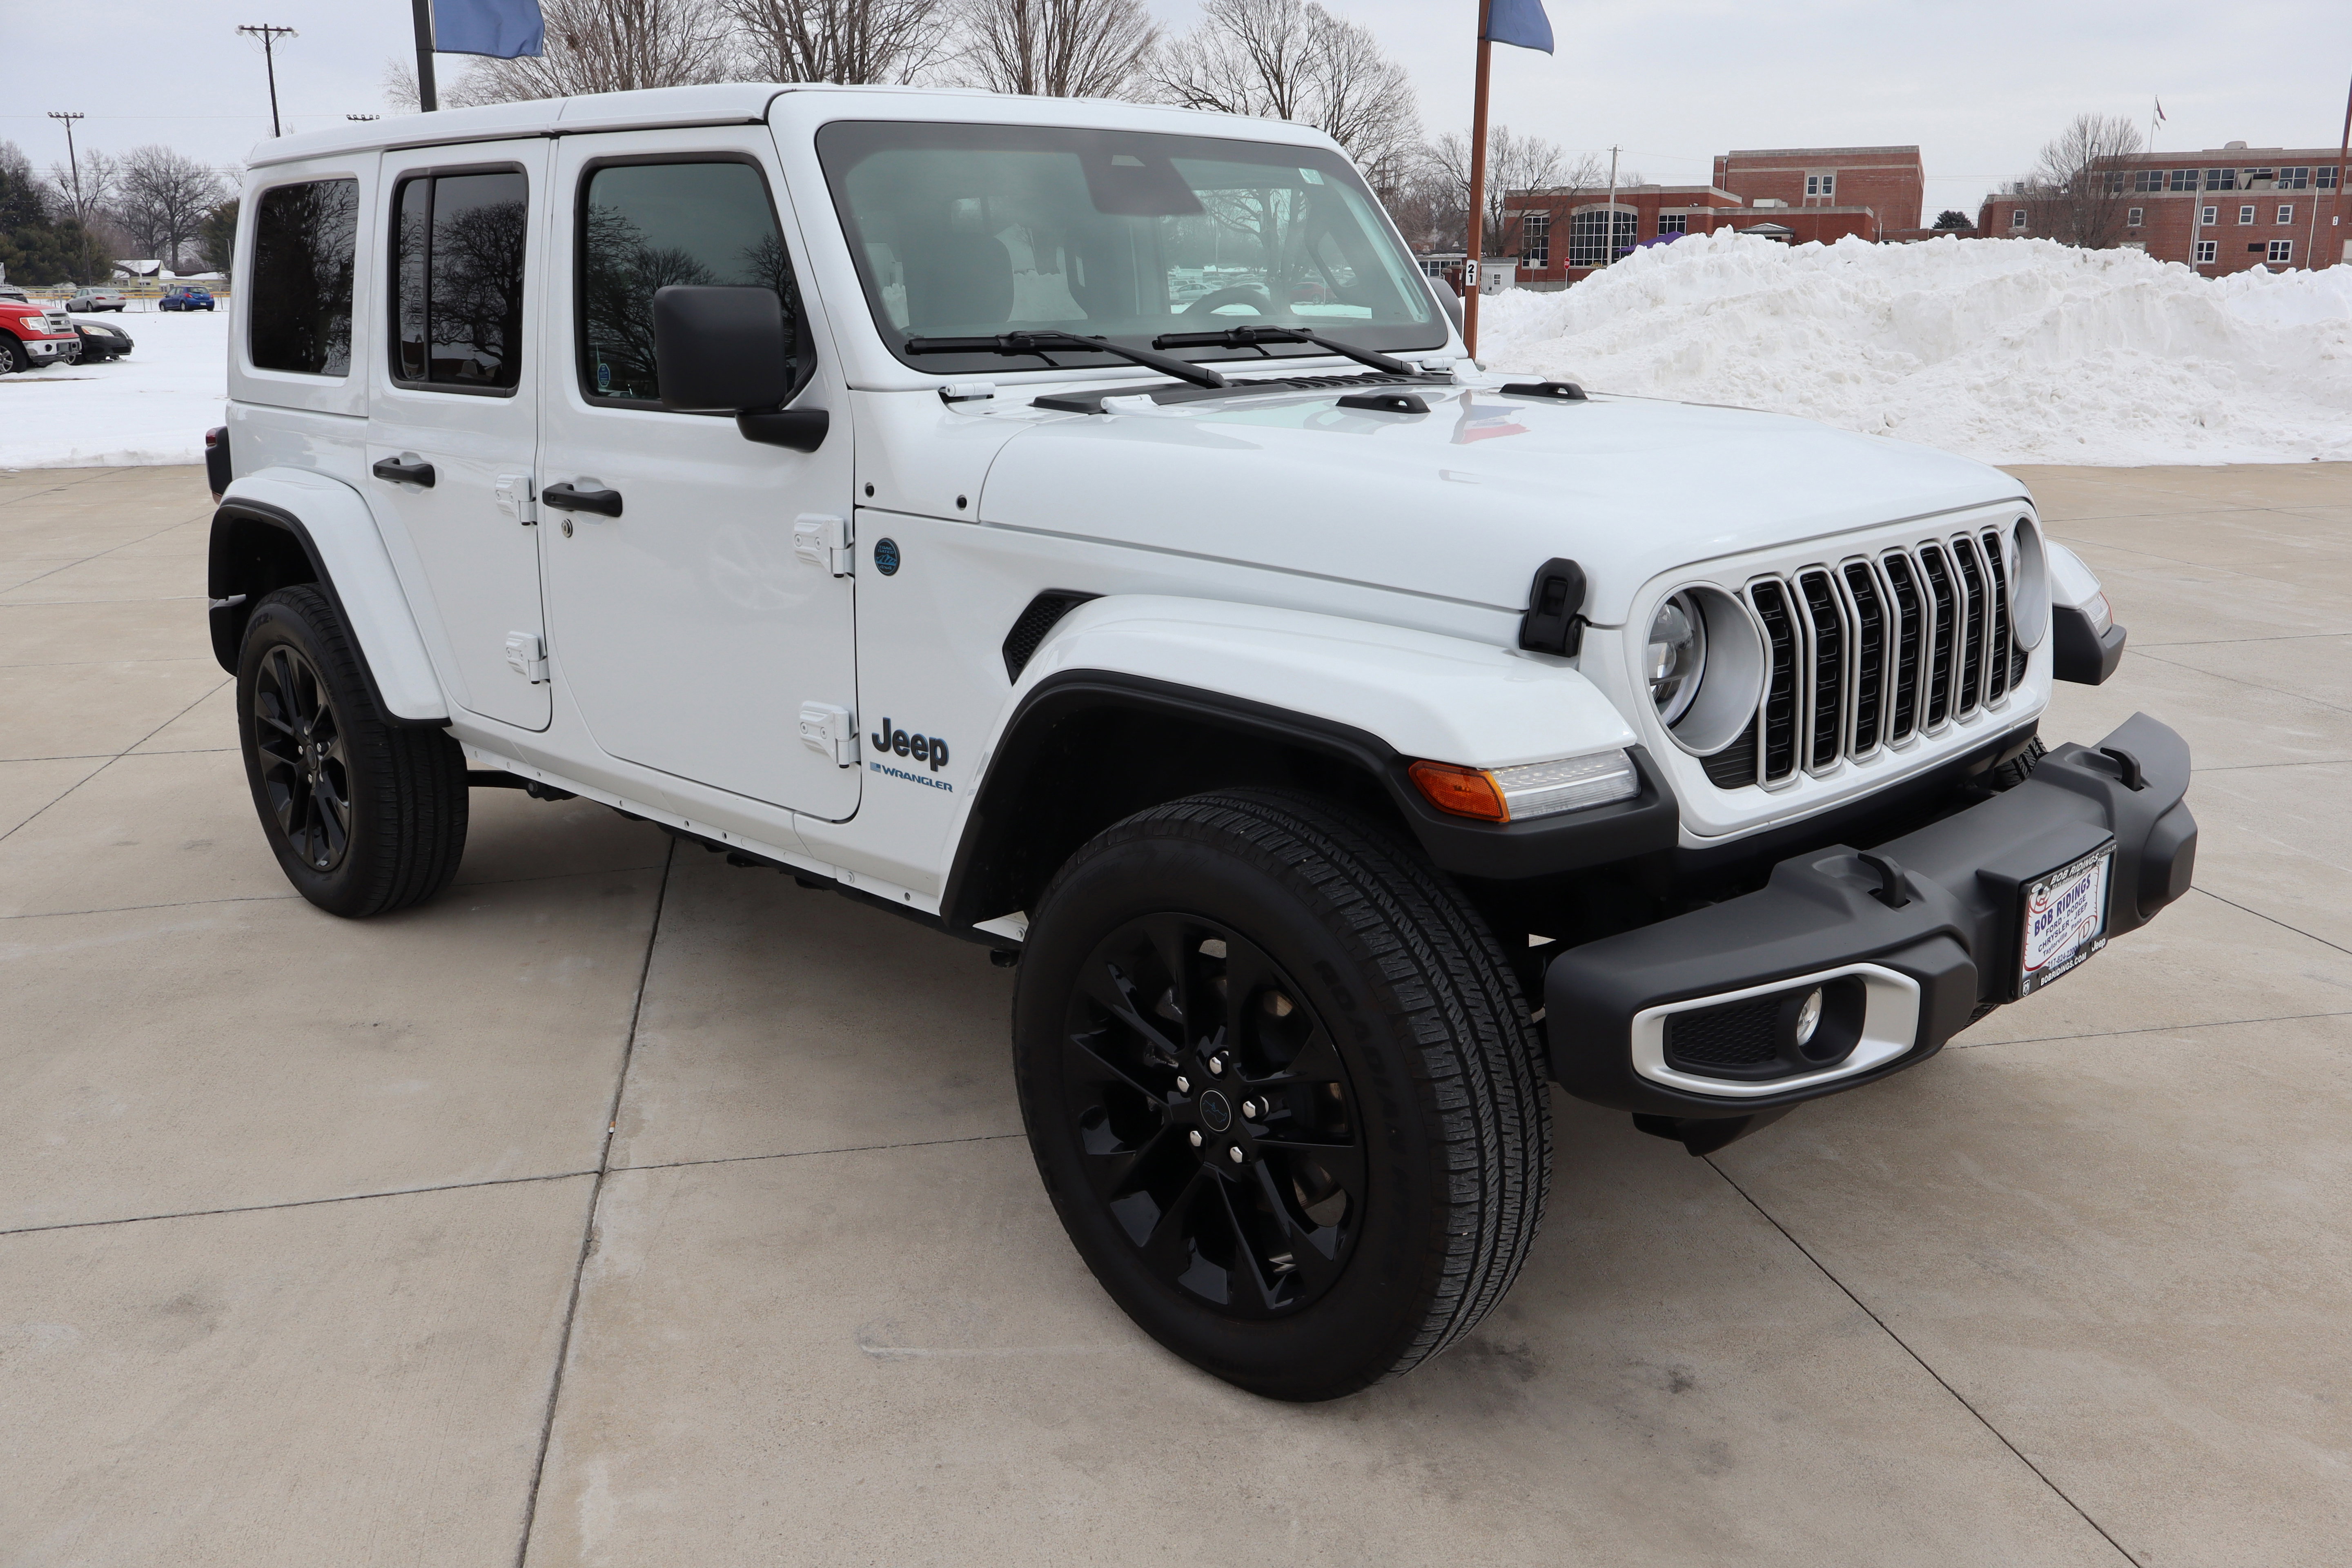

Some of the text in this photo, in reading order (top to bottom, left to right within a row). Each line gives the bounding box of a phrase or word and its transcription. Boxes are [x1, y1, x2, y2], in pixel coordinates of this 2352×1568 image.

[1468, 264, 1474, 283] 21
[872, 717, 949, 772] Jeep
[882, 765, 953, 793] WRANGLER
[2050, 853, 2100, 886] BOB RIDINGS
[2034, 873, 2091, 937] BOB RIDINGS
[2046, 918, 2062, 937] FORD
[2067, 893, 2087, 917] DODGE
[2038, 920, 2070, 953] CHRYSLER
[2074, 902, 2088, 920] JEEP
[2043, 918, 2082, 957] Taylorville Pana
[2091, 938, 2106, 952] Jeep
[2040, 952, 2087, 986] BOBRIDINGS.COM
[2047, 945, 2078, 969] 217-824-2200
[1312, 960, 1408, 1156] ROADIAN
